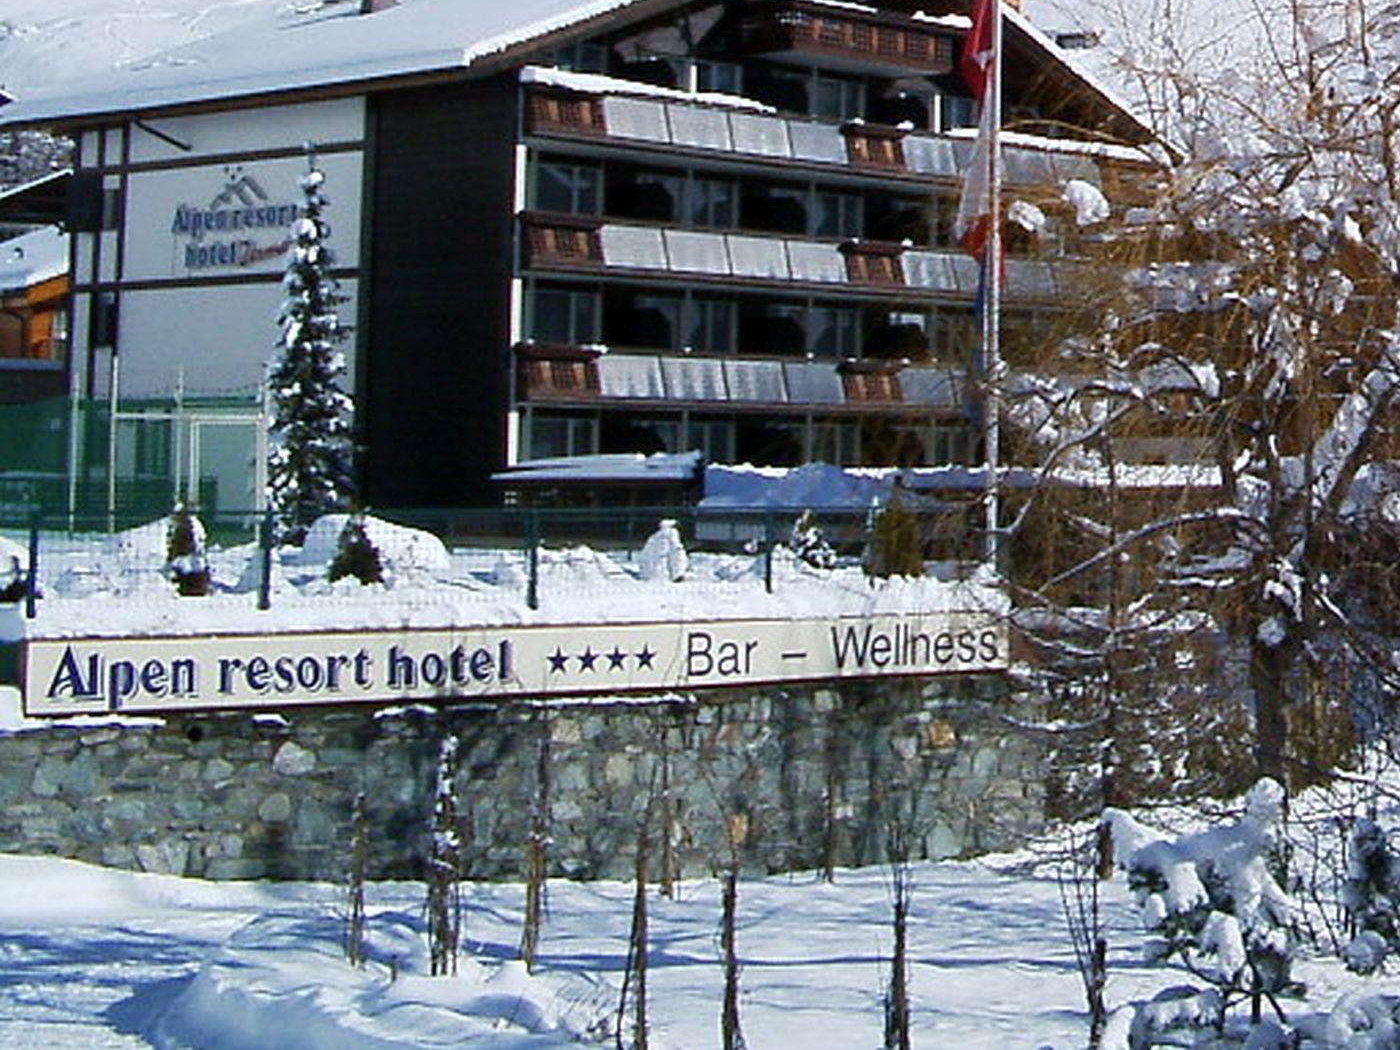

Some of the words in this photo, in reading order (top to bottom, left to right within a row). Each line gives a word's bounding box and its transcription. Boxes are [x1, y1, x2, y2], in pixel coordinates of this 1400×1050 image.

[171, 202, 227, 239] Alpen
[184, 241, 236, 268] hotel
[47, 644, 200, 709] Alpen
[217, 646, 372, 695] resort
[385, 639, 515, 688] hotel
[686, 632, 758, 677] Bar
[830, 623, 1000, 669] Wellness
